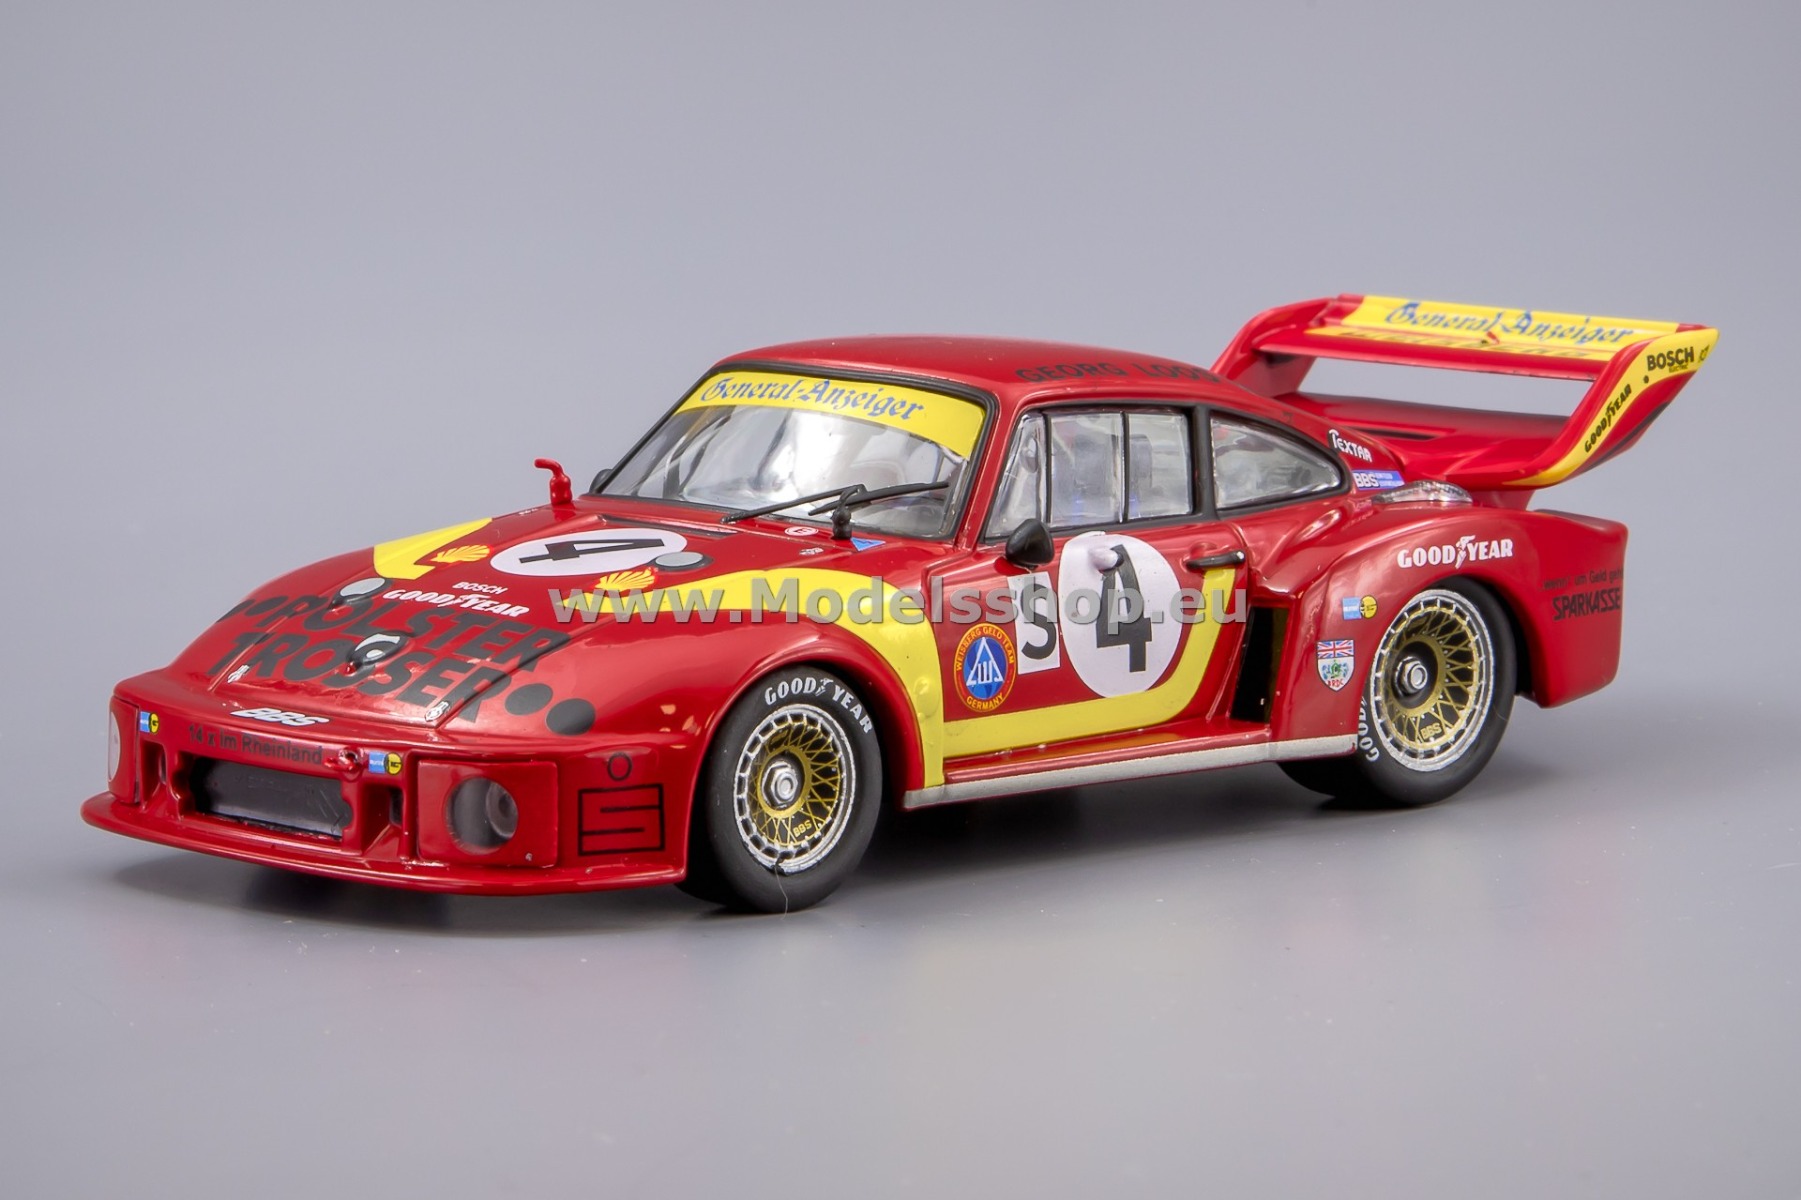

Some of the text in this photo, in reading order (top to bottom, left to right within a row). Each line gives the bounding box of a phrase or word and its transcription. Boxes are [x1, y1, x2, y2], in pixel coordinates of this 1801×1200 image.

[1646, 346, 1695, 372] BOSCH
[1015, 363, 1128, 383] GEORG
[1353, 473, 1380, 488] BBS
[519, 538, 665, 564] 4
[452, 581, 508, 595] BOSCH
[1096, 545, 1152, 673] 4
[1552, 587, 1620, 621] SPARKASSE
[256, 594, 572, 673] POLSTER
[1021, 584, 1056, 660] S
[1002, 637, 1015, 665] TEAM
[966, 692, 1004, 710] GERMANY
[230, 708, 329, 726] BBS
[189, 723, 203, 745] 14
[208, 731, 217, 747] x
[242, 732, 323, 765] Rheinland
[1421, 722, 1442, 740] BBS
[792, 819, 812, 838] BBS
